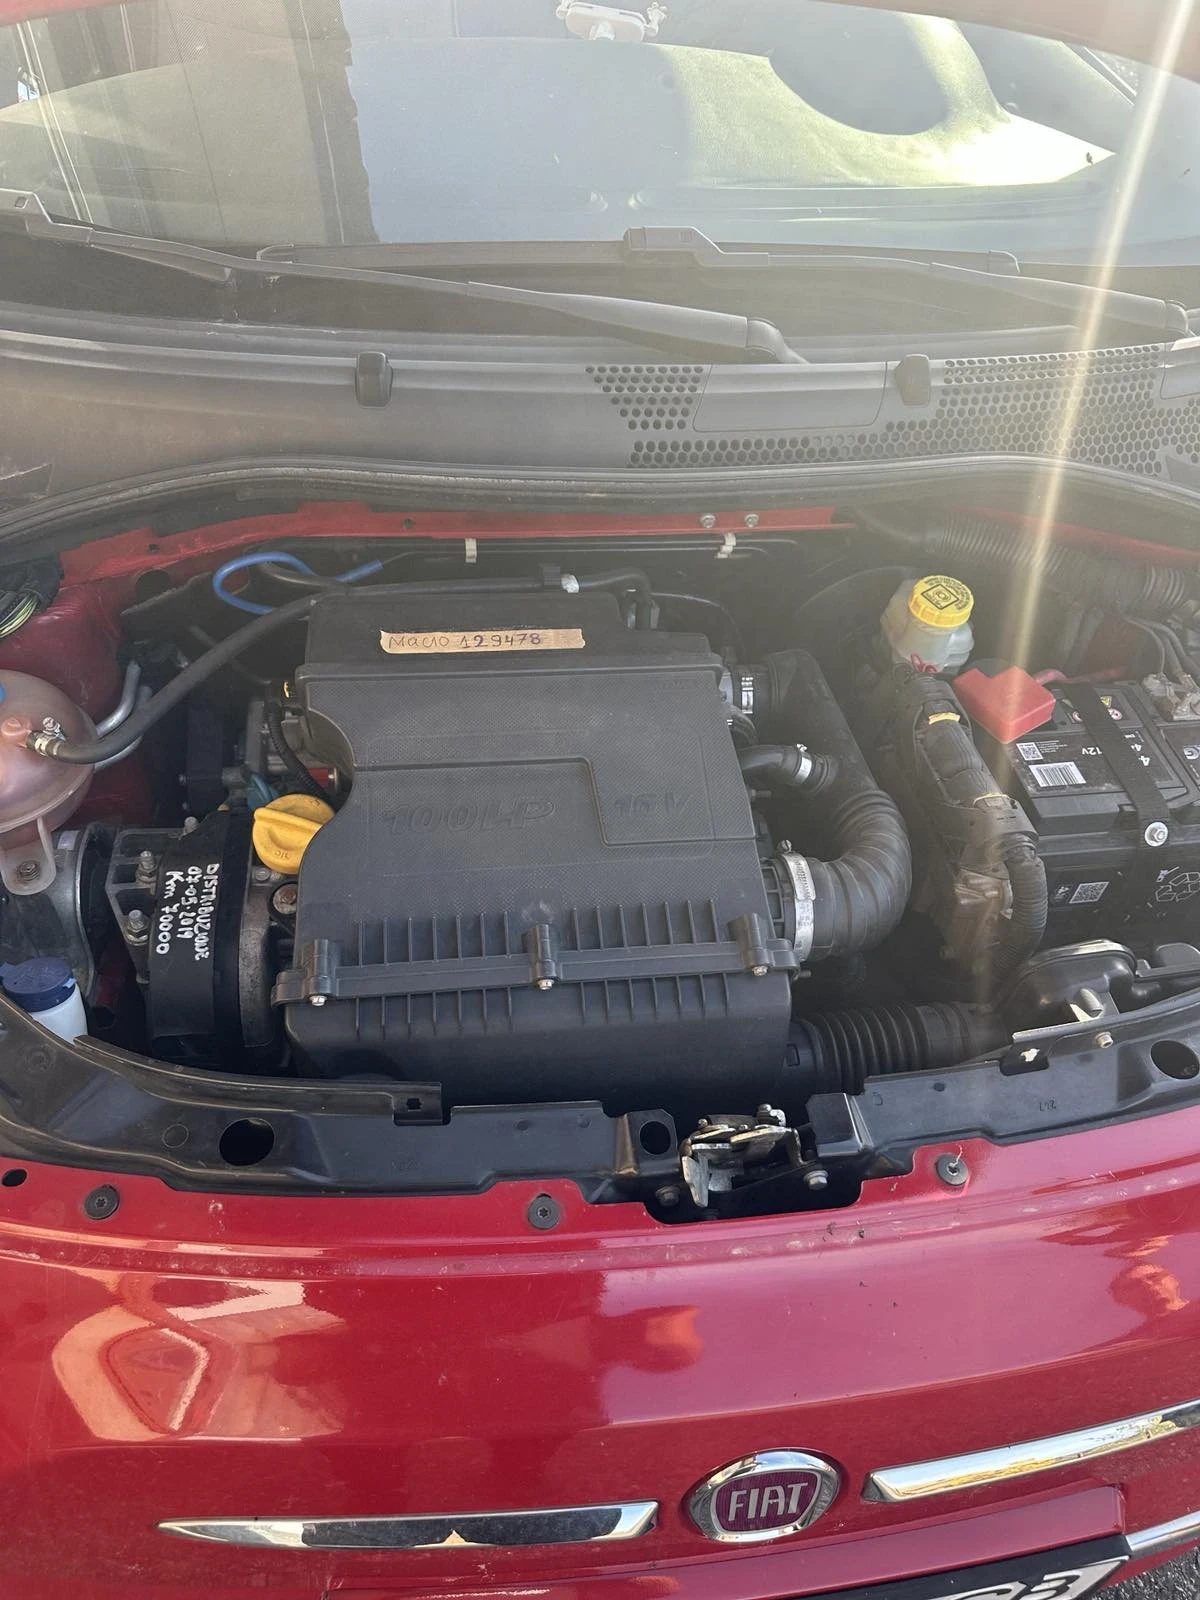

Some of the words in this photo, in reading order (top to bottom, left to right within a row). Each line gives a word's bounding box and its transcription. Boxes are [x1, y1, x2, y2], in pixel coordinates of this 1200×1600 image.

[459, 632, 542, 648] 129478
[163, 871, 185, 899] Km
[156, 903, 180, 955] 70000
[728, 1482, 808, 1522] FIAT
